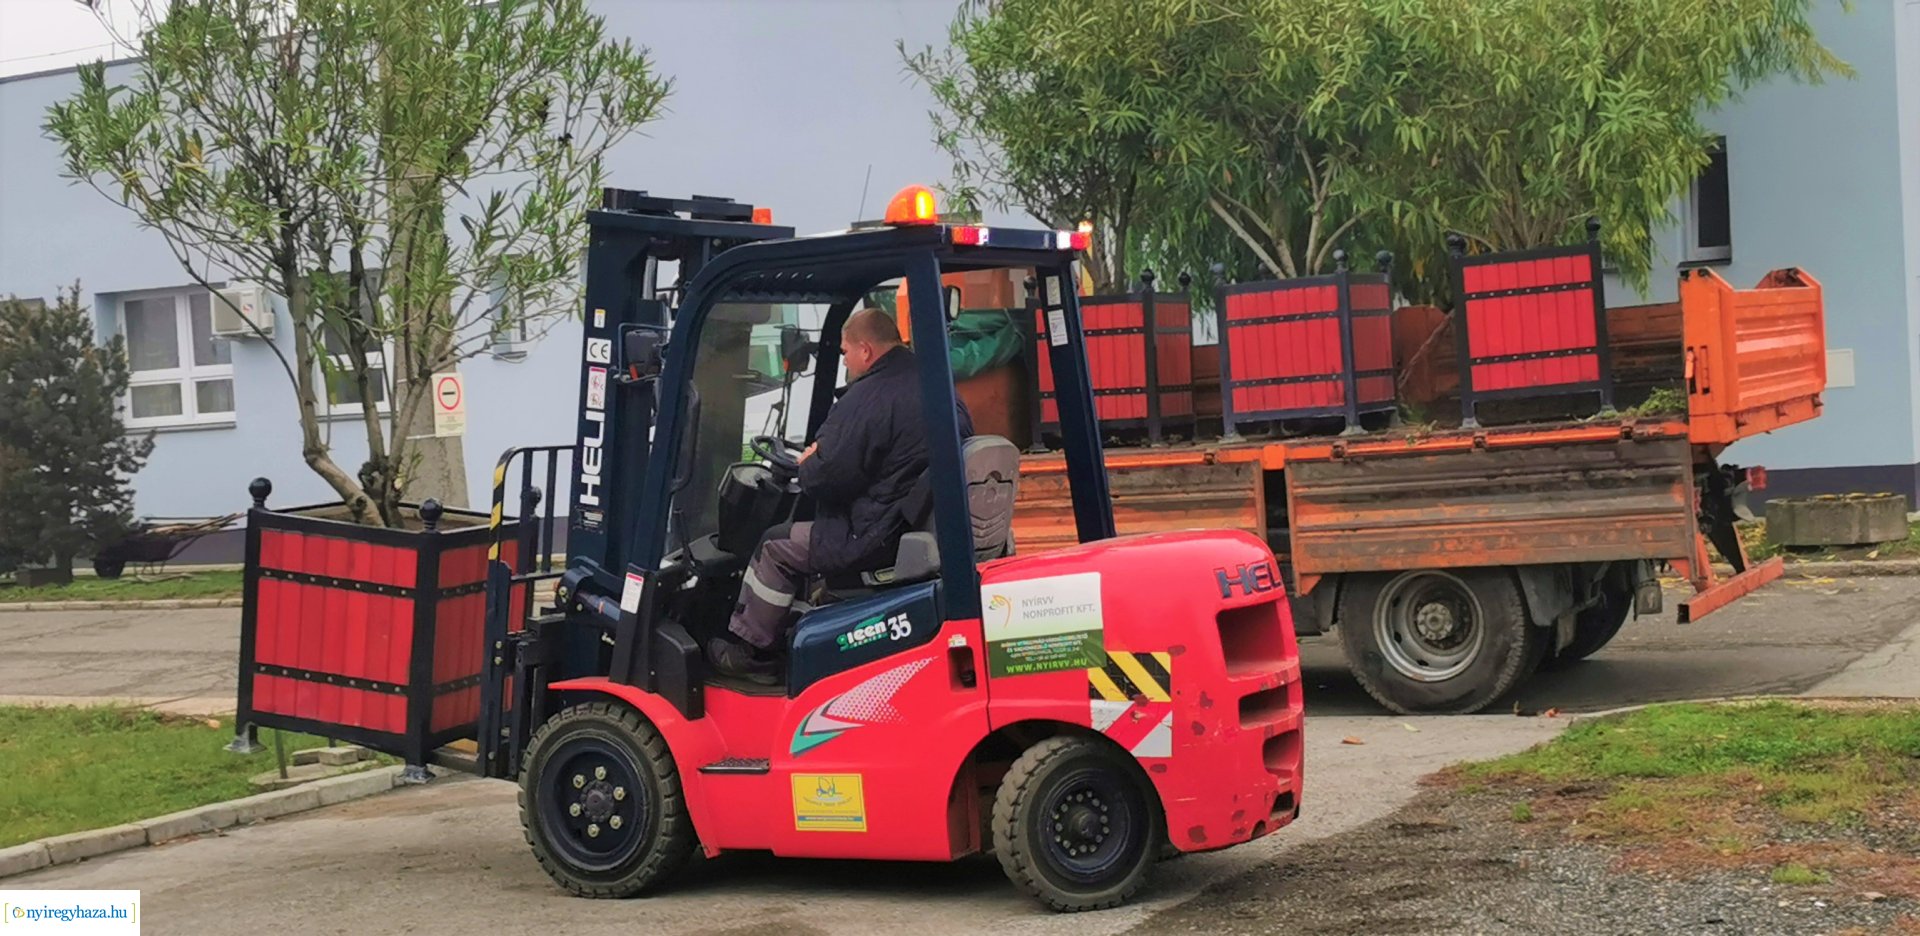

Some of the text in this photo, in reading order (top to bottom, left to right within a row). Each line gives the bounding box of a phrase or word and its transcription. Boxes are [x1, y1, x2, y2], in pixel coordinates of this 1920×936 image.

[579, 410, 606, 506] HELI
[1023, 603, 1096, 619] NONPROFIT KFT.
[887, 613, 912, 640] 35
[1006, 658, 1088, 674] WWW.NYIRVV.HU
